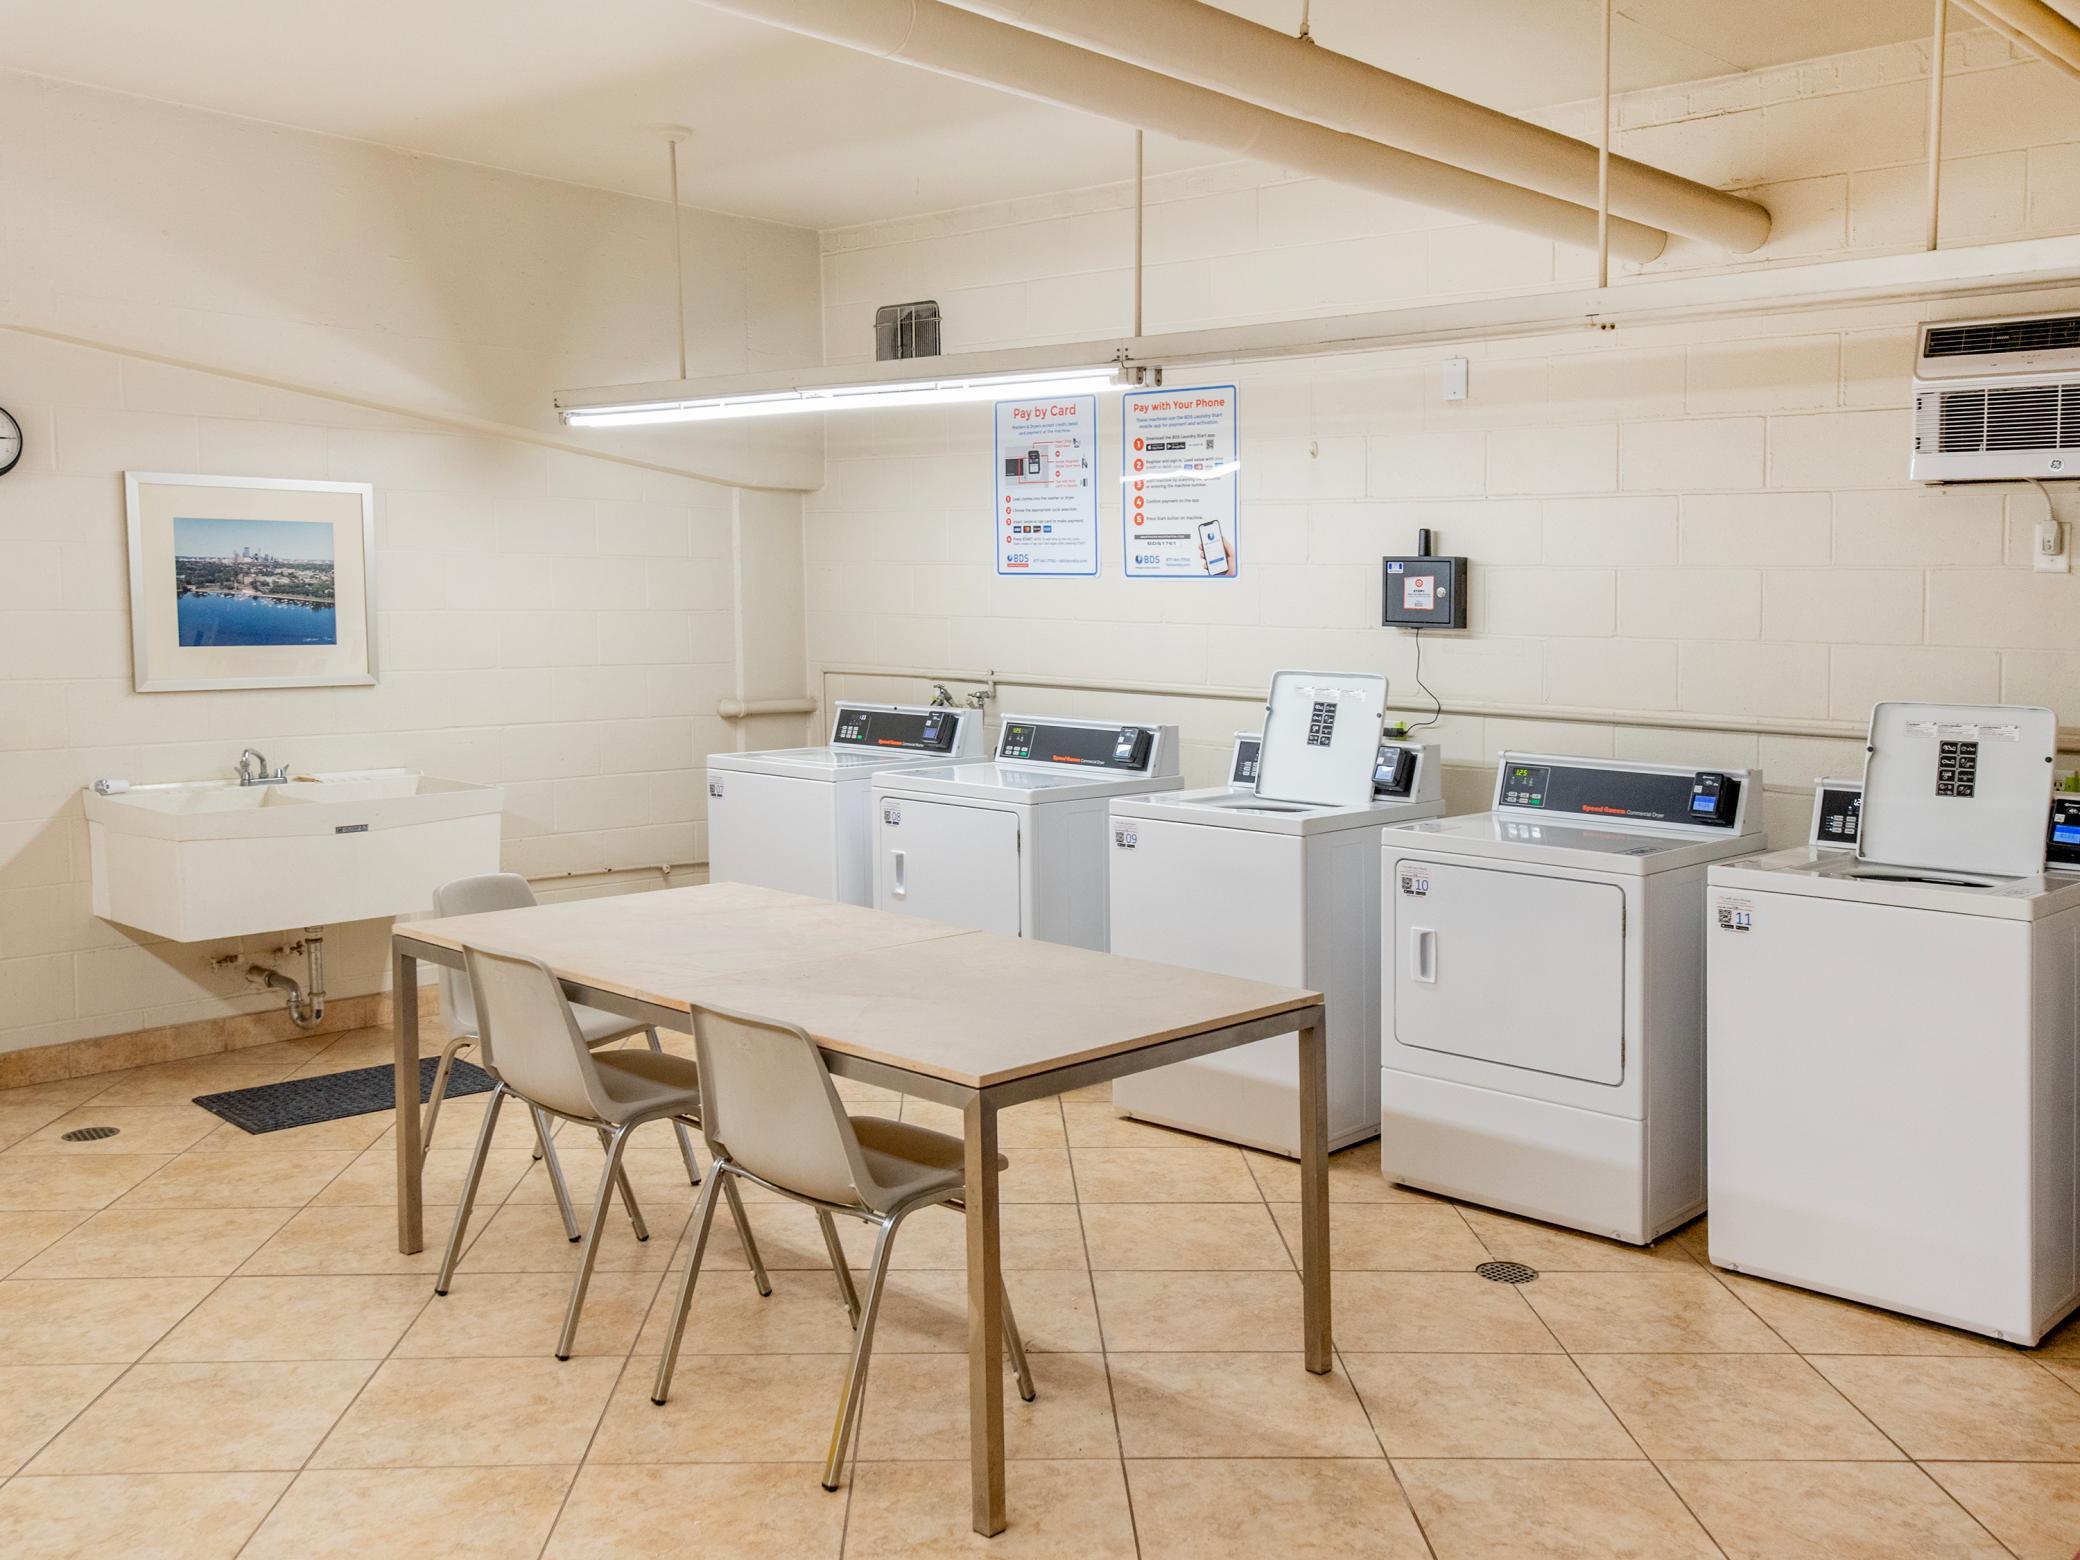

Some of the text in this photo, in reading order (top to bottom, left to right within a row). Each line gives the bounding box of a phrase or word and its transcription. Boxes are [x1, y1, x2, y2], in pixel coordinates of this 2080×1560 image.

[1013, 403, 1076, 421] Pay by Card
[1133, 398, 1225, 414] Pay with Your Phone
[1013, 554, 1029, 563] BDS
[1144, 555, 1160, 564] BDS
[892, 811, 901, 822] 08
[1126, 832, 1137, 844] 09
[1415, 879, 1429, 892] 10
[1735, 911, 1752, 926] 11
